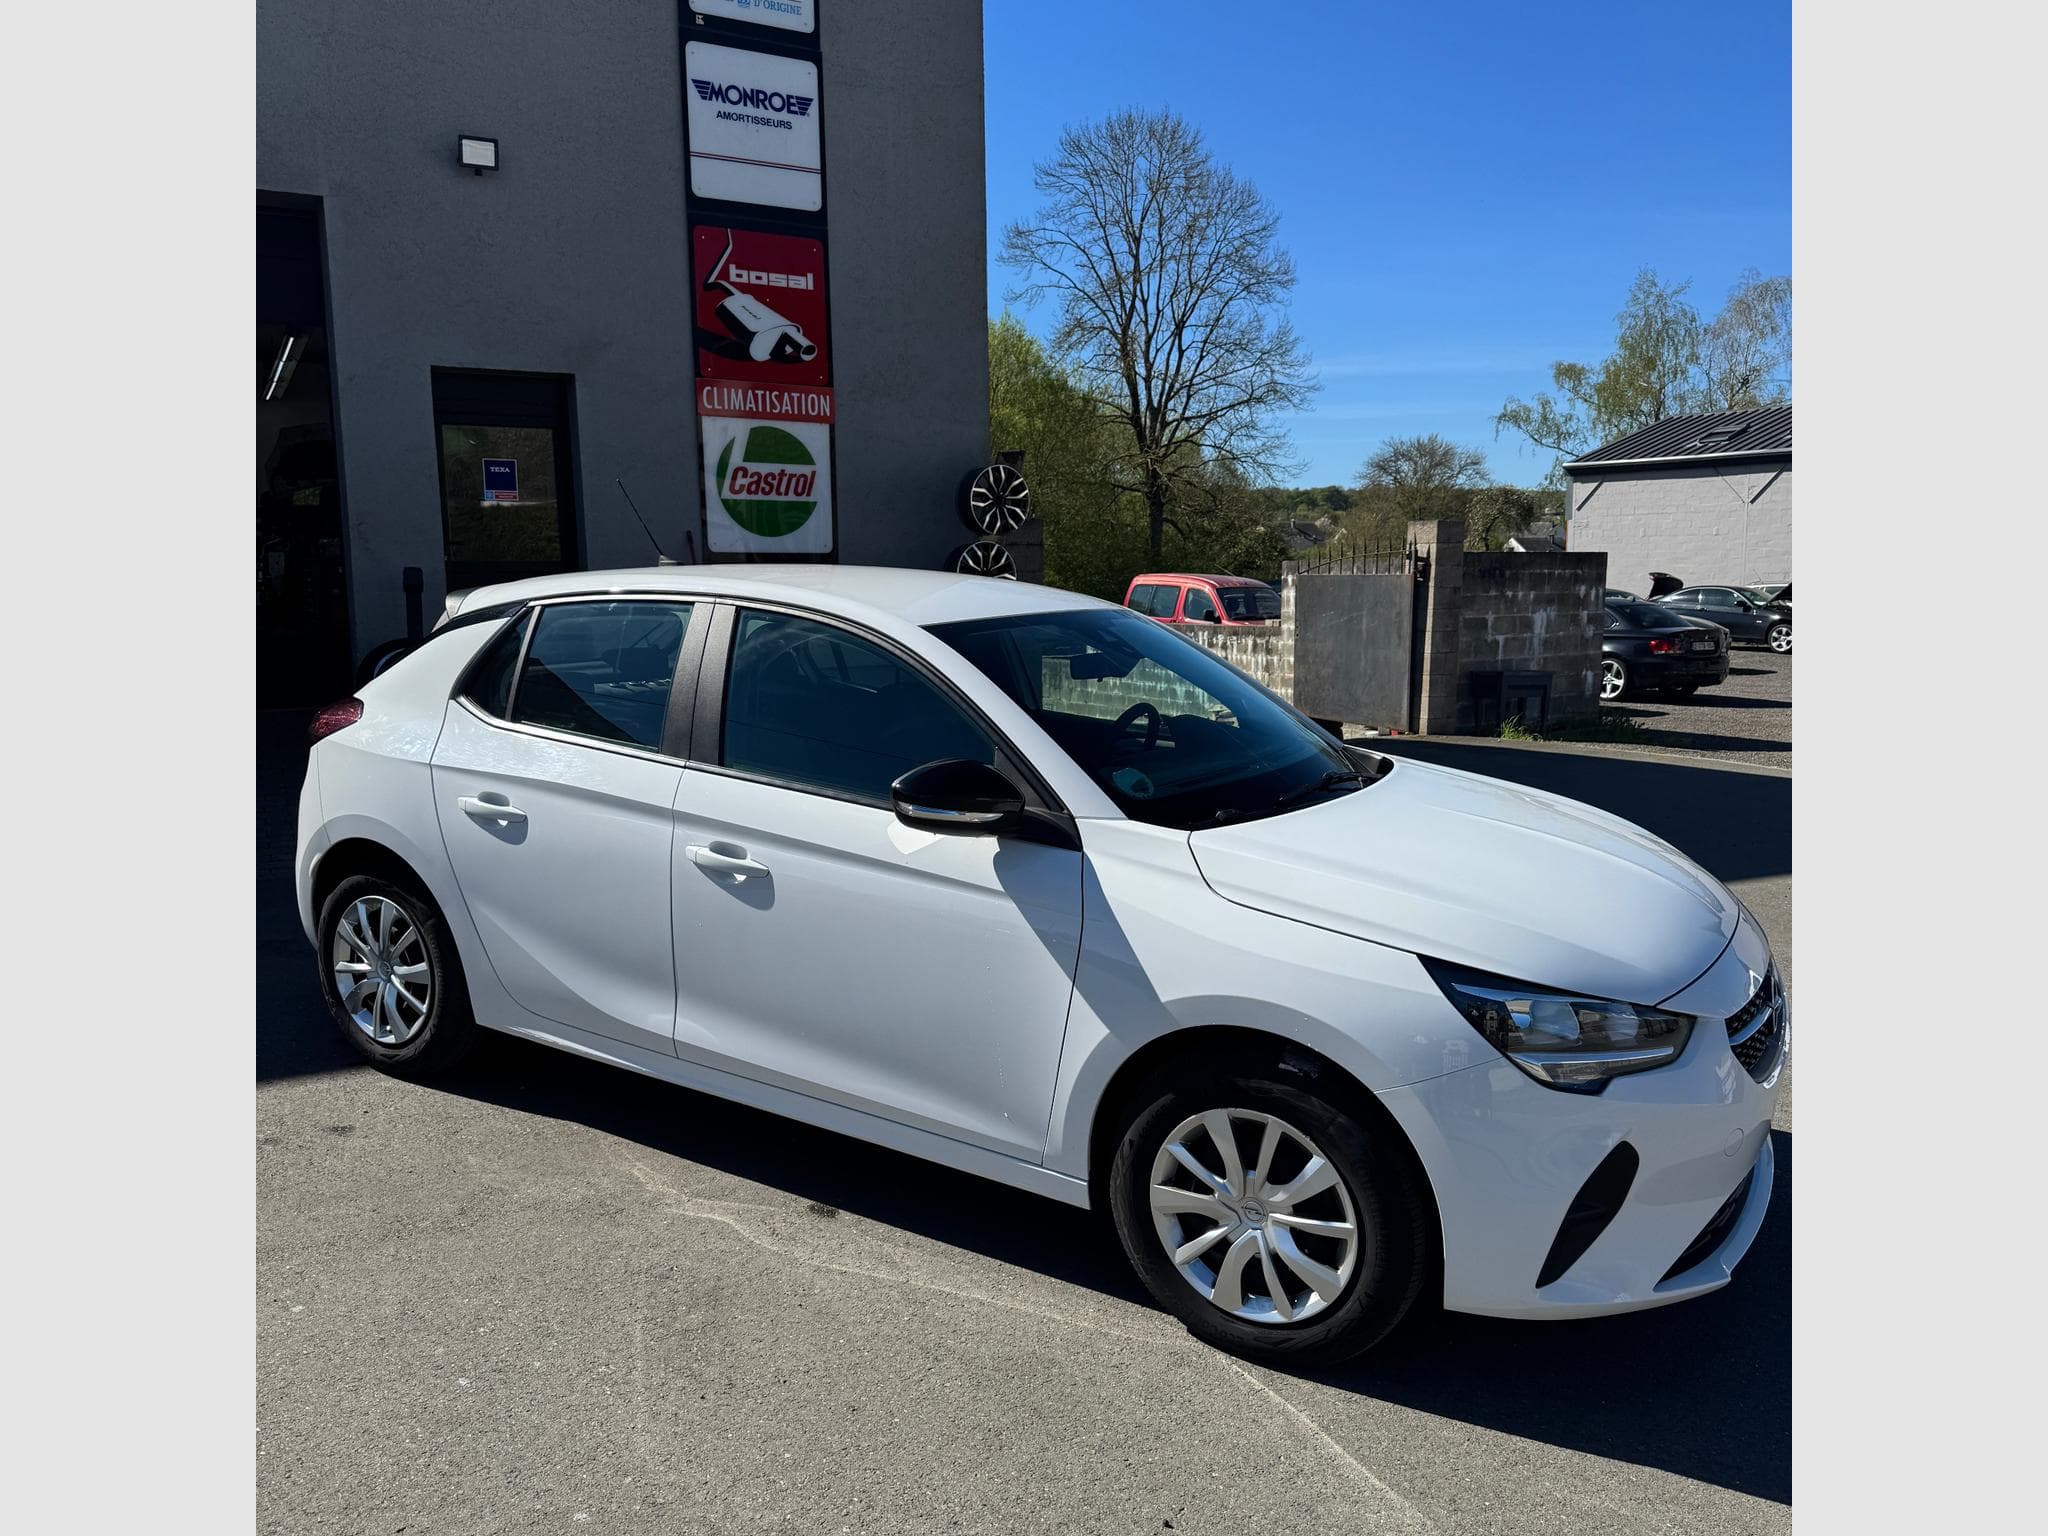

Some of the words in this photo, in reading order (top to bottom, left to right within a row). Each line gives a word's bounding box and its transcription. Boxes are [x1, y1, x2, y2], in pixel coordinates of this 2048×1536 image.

[708, 82, 799, 116] MONROE
[716, 110, 793, 130] AMORTISSEURS
[729, 264, 814, 290] bosal
[702, 386, 831, 417] CLIMATISATION
[728, 466, 817, 497] Castrol
